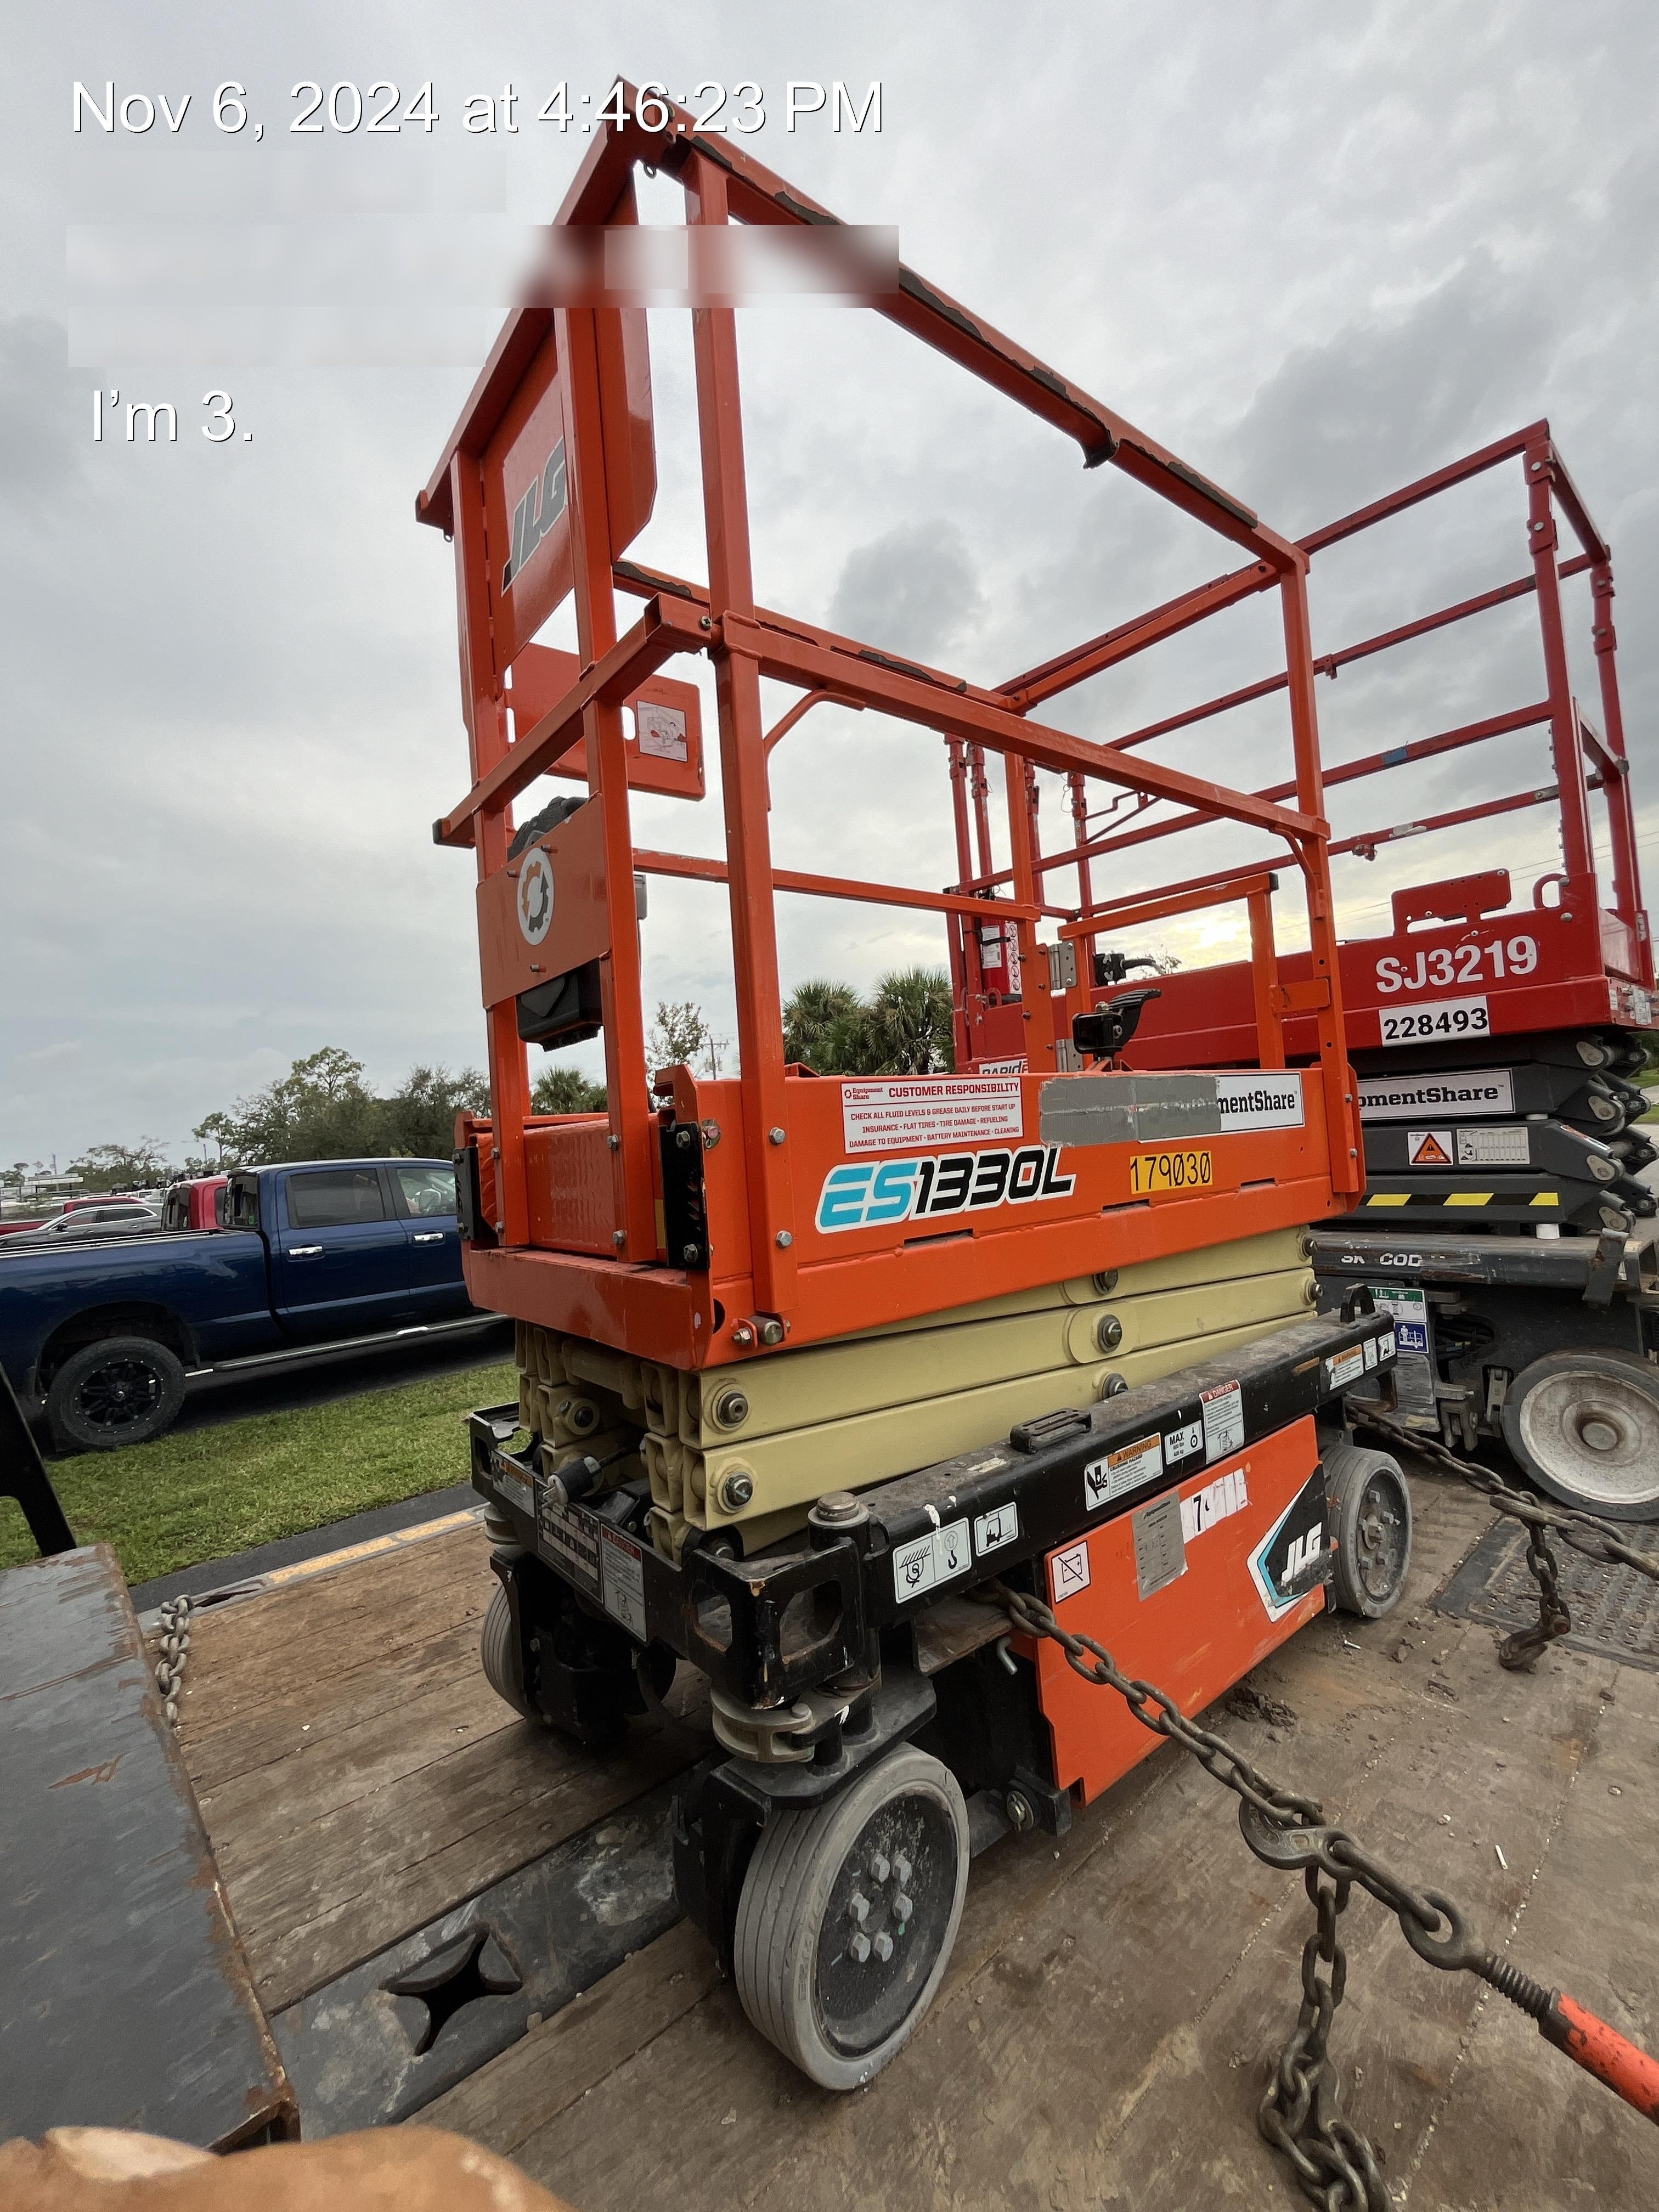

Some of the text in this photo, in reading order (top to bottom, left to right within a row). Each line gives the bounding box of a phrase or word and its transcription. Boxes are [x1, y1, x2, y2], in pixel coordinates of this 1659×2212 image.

[1376, 935, 1537, 992] SJ3219
[1384, 1008, 1488, 1040] 228493
[889, 1086, 943, 1097] CUSTOMER
[945, 1082, 1019, 1095] RESPONSIBILITY
[862, 1124, 899, 1133] INSURANCE
[904, 1122, 917, 1130] FLAT
[849, 1139, 876, 1148] DAMAGE
[887, 1135, 923, 1145] EQUIPMENT
[927, 1132, 951, 1141] BATTERY
[952, 1128, 991, 1138] MAINTENANCE
[820, 1146, 1074, 1228] ES1330L
[1212, 1384, 1234, 1397] DANGER
[1170, 1431, 1184, 1445] MAX
[1122, 1440, 1152, 1459] WARNING
[1281, 1522, 1322, 1586] JLG
